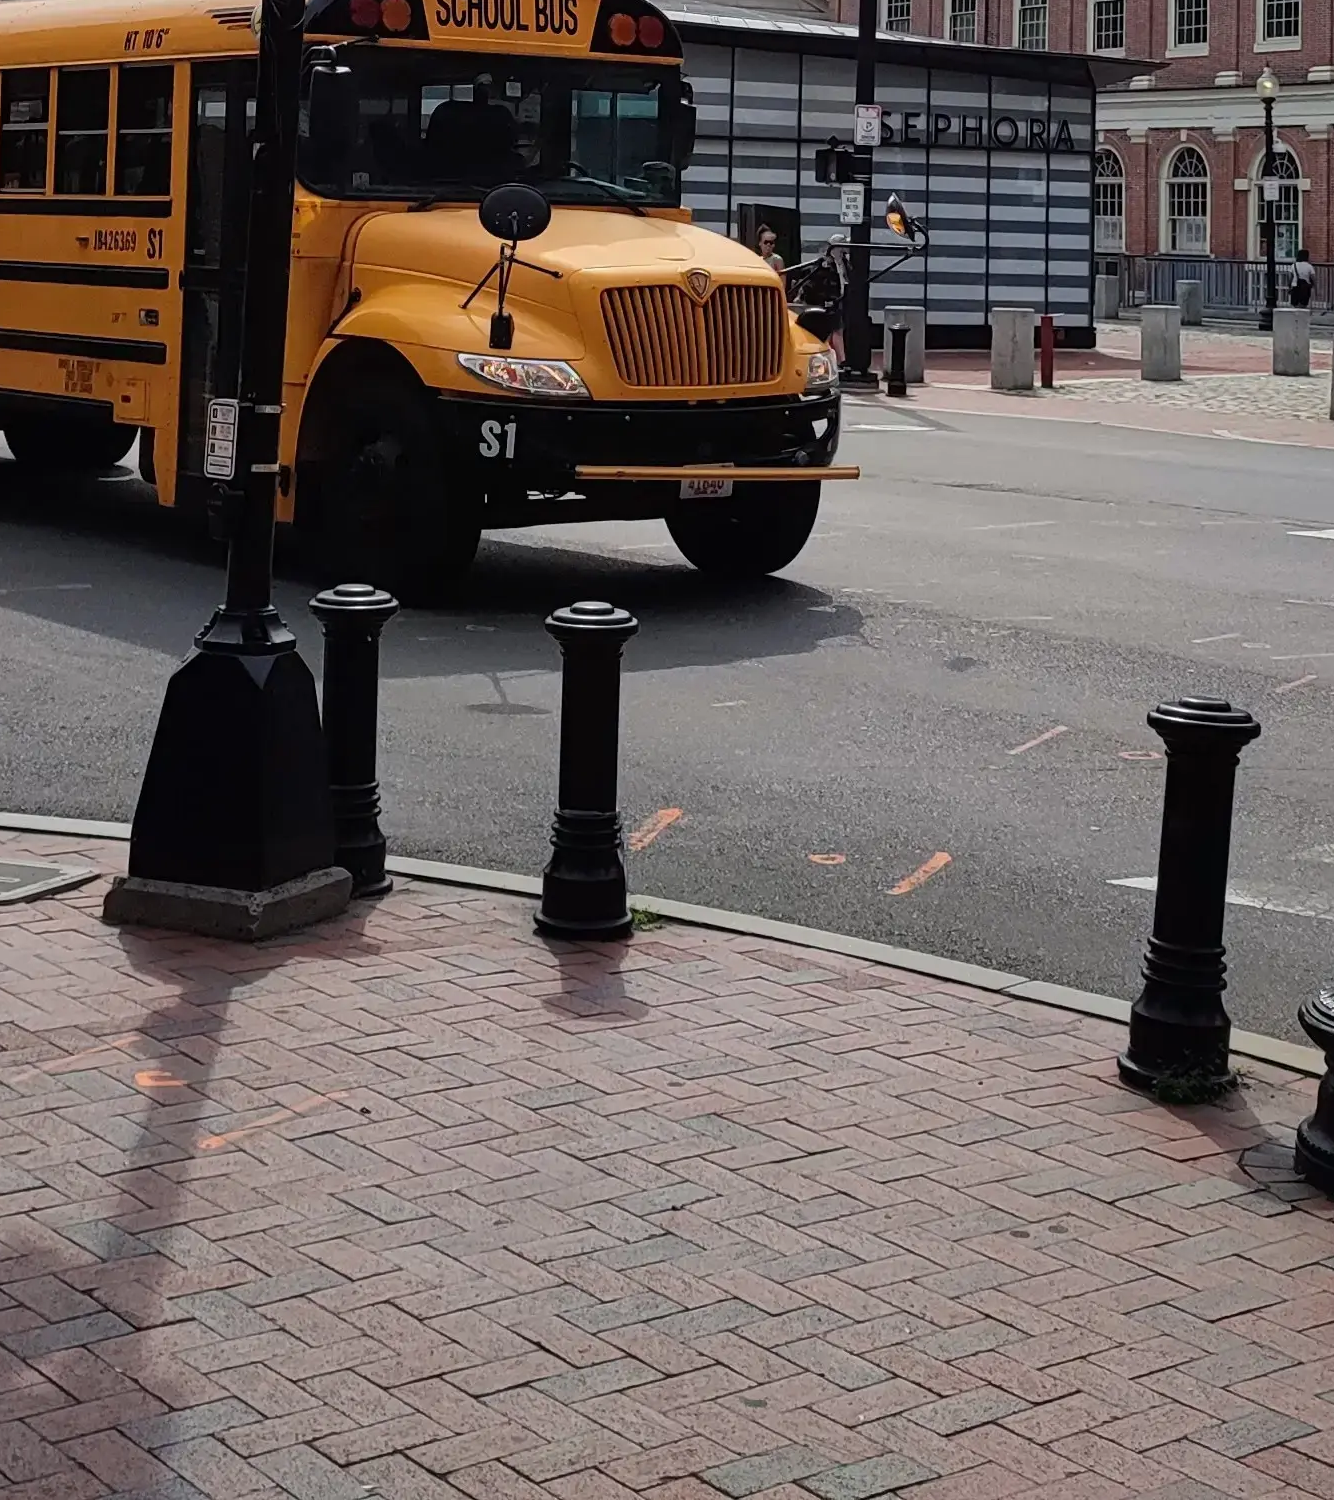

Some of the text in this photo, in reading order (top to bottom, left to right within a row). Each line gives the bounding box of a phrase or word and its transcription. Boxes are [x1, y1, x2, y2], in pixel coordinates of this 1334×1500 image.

[124, 31, 139, 50] HT
[881, 110, 1075, 150] SEPHORA
[147, 228, 163, 259] S1
[479, 420, 516, 458] S1
